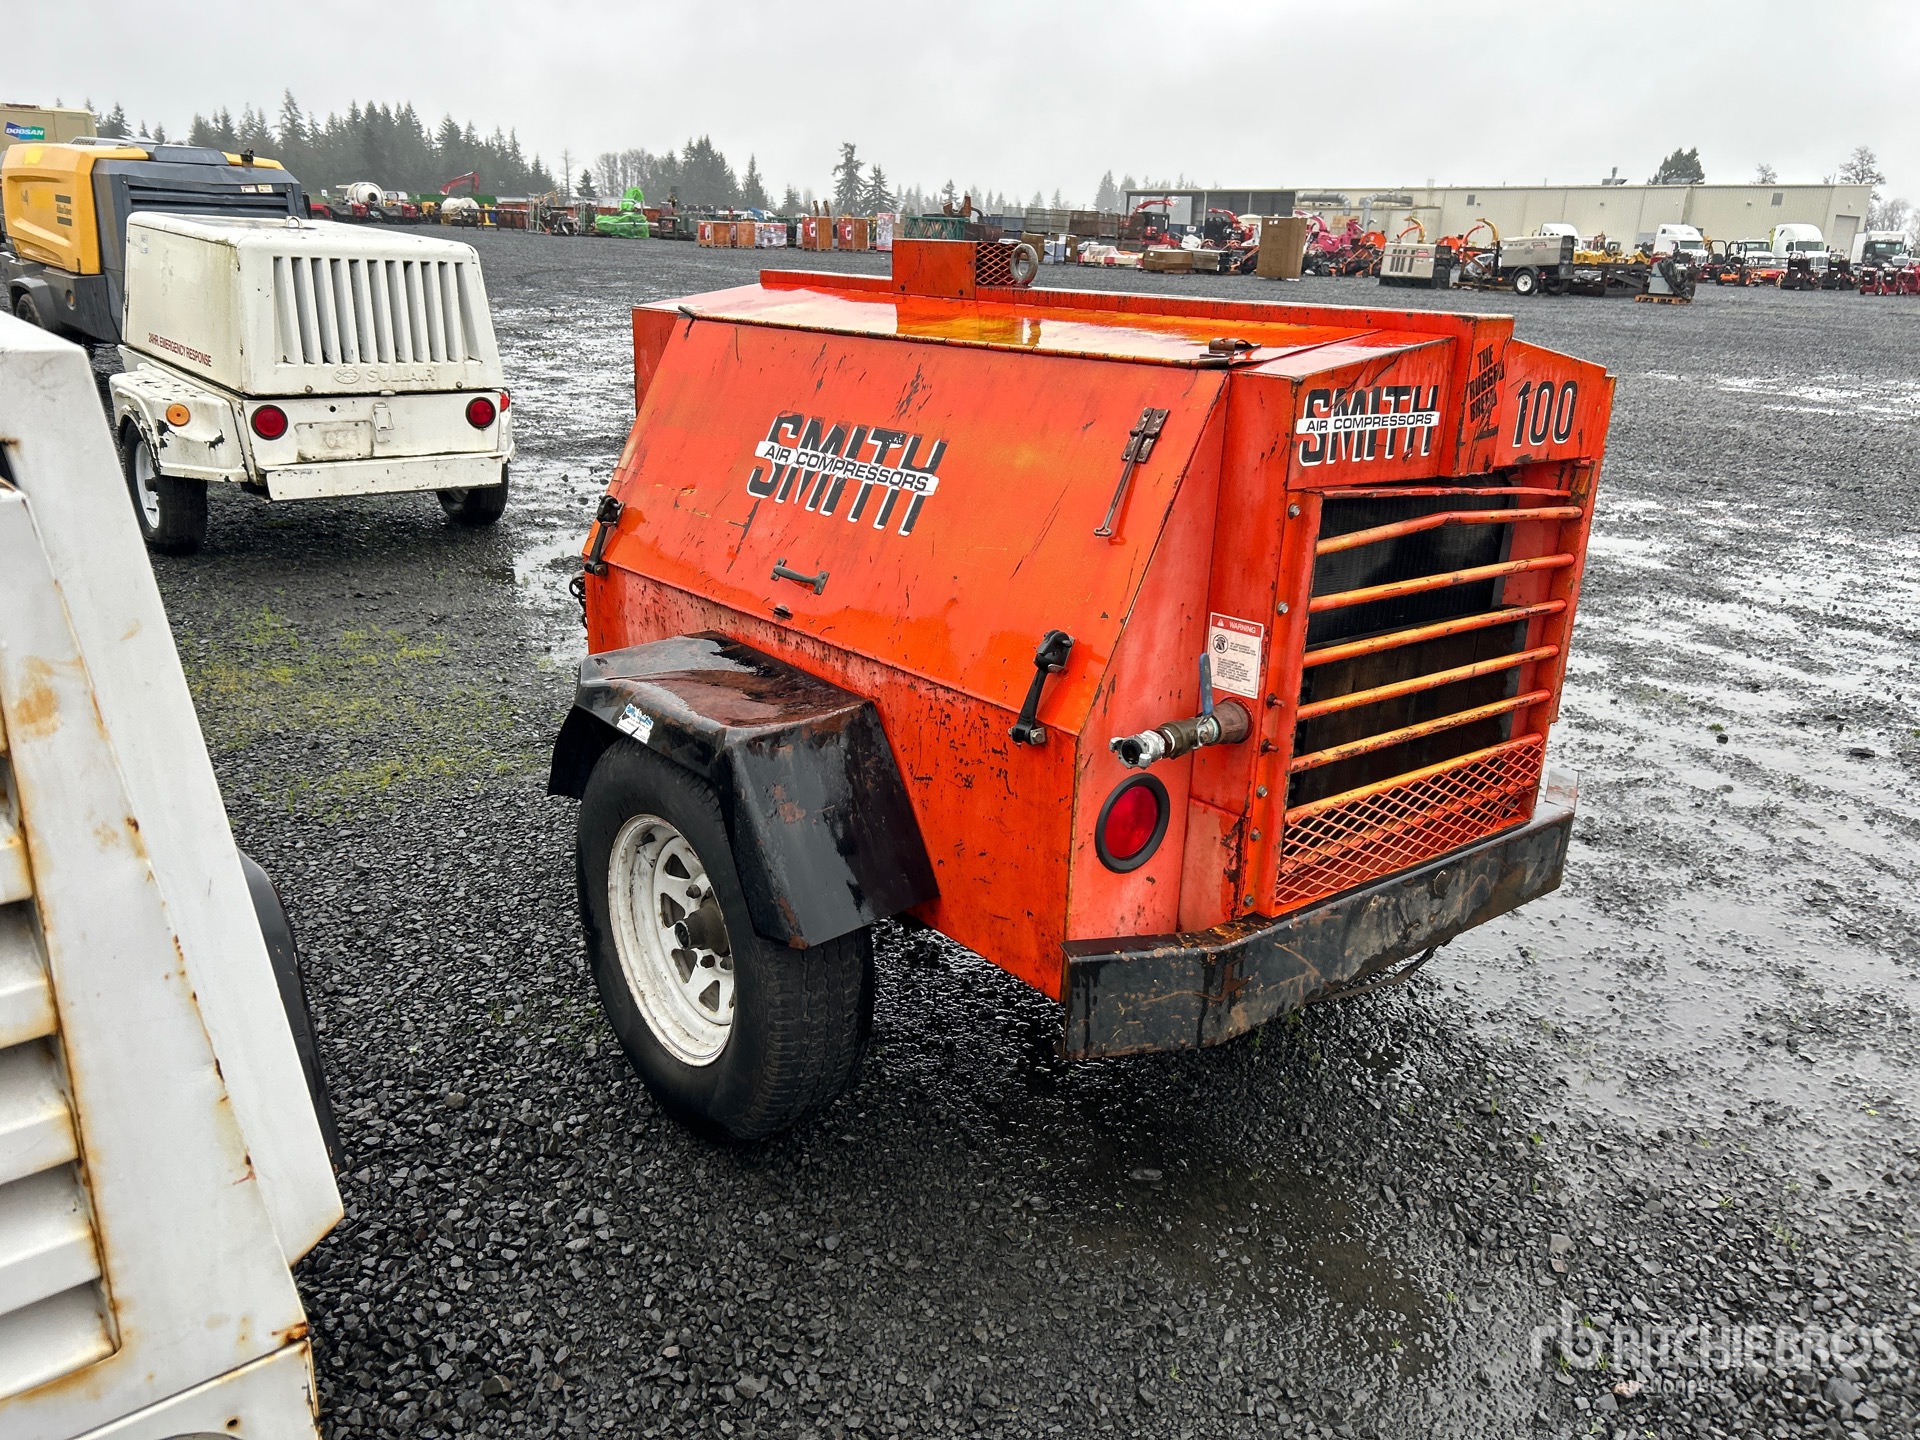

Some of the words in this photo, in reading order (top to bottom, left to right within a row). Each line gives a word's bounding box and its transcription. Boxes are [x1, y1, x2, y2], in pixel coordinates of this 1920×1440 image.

[5, 127, 44, 136] DOOSAN
[159, 336, 186, 357] EMERGENCY
[186, 347, 212, 368] RESPONSE
[1477, 344, 1493, 373] THE
[366, 366, 437, 383] SULLAIR
[1299, 384, 1439, 467] SMITH
[1306, 420, 1328, 432] AIR
[1333, 413, 1432, 430] COMPRESSORS
[1512, 380, 1578, 447] 100
[747, 410, 950, 537] SMITH
[764, 445, 791, 463] AIR
[795, 451, 929, 492] COMPRESSORS
[1228, 620, 1257, 635] WARNING
